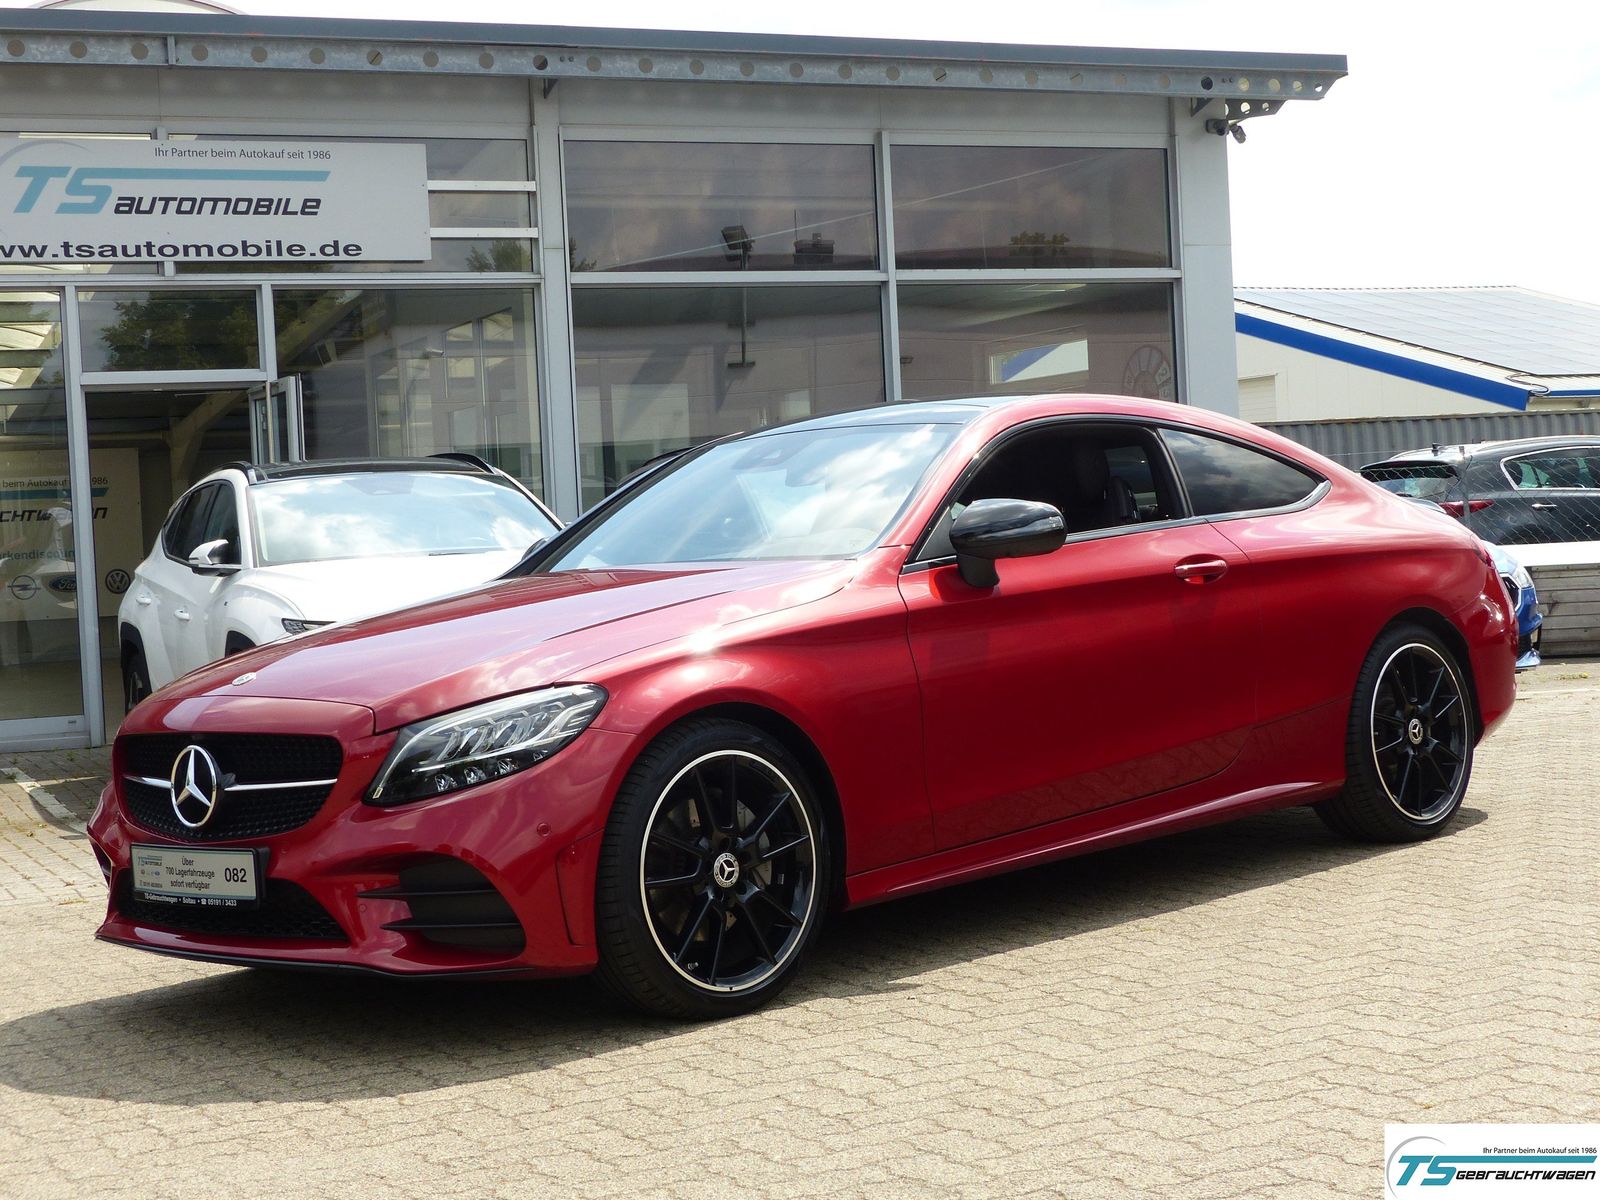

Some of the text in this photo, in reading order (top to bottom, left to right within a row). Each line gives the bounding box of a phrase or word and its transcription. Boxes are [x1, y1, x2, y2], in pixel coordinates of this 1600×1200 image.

[154, 147, 332, 160] Ihr Partner beim Autokauf seit 1986
[13, 165, 113, 214] TS
[2, 476, 109, 488] beim Autokauf 986
[181, 856, 194, 866] Über
[165, 866, 215, 879] 700 Lagerfahrzeuge
[224, 867, 247, 883] 082
[170, 879, 185, 888] sofort
[185, 880, 211, 891] verfügbar
